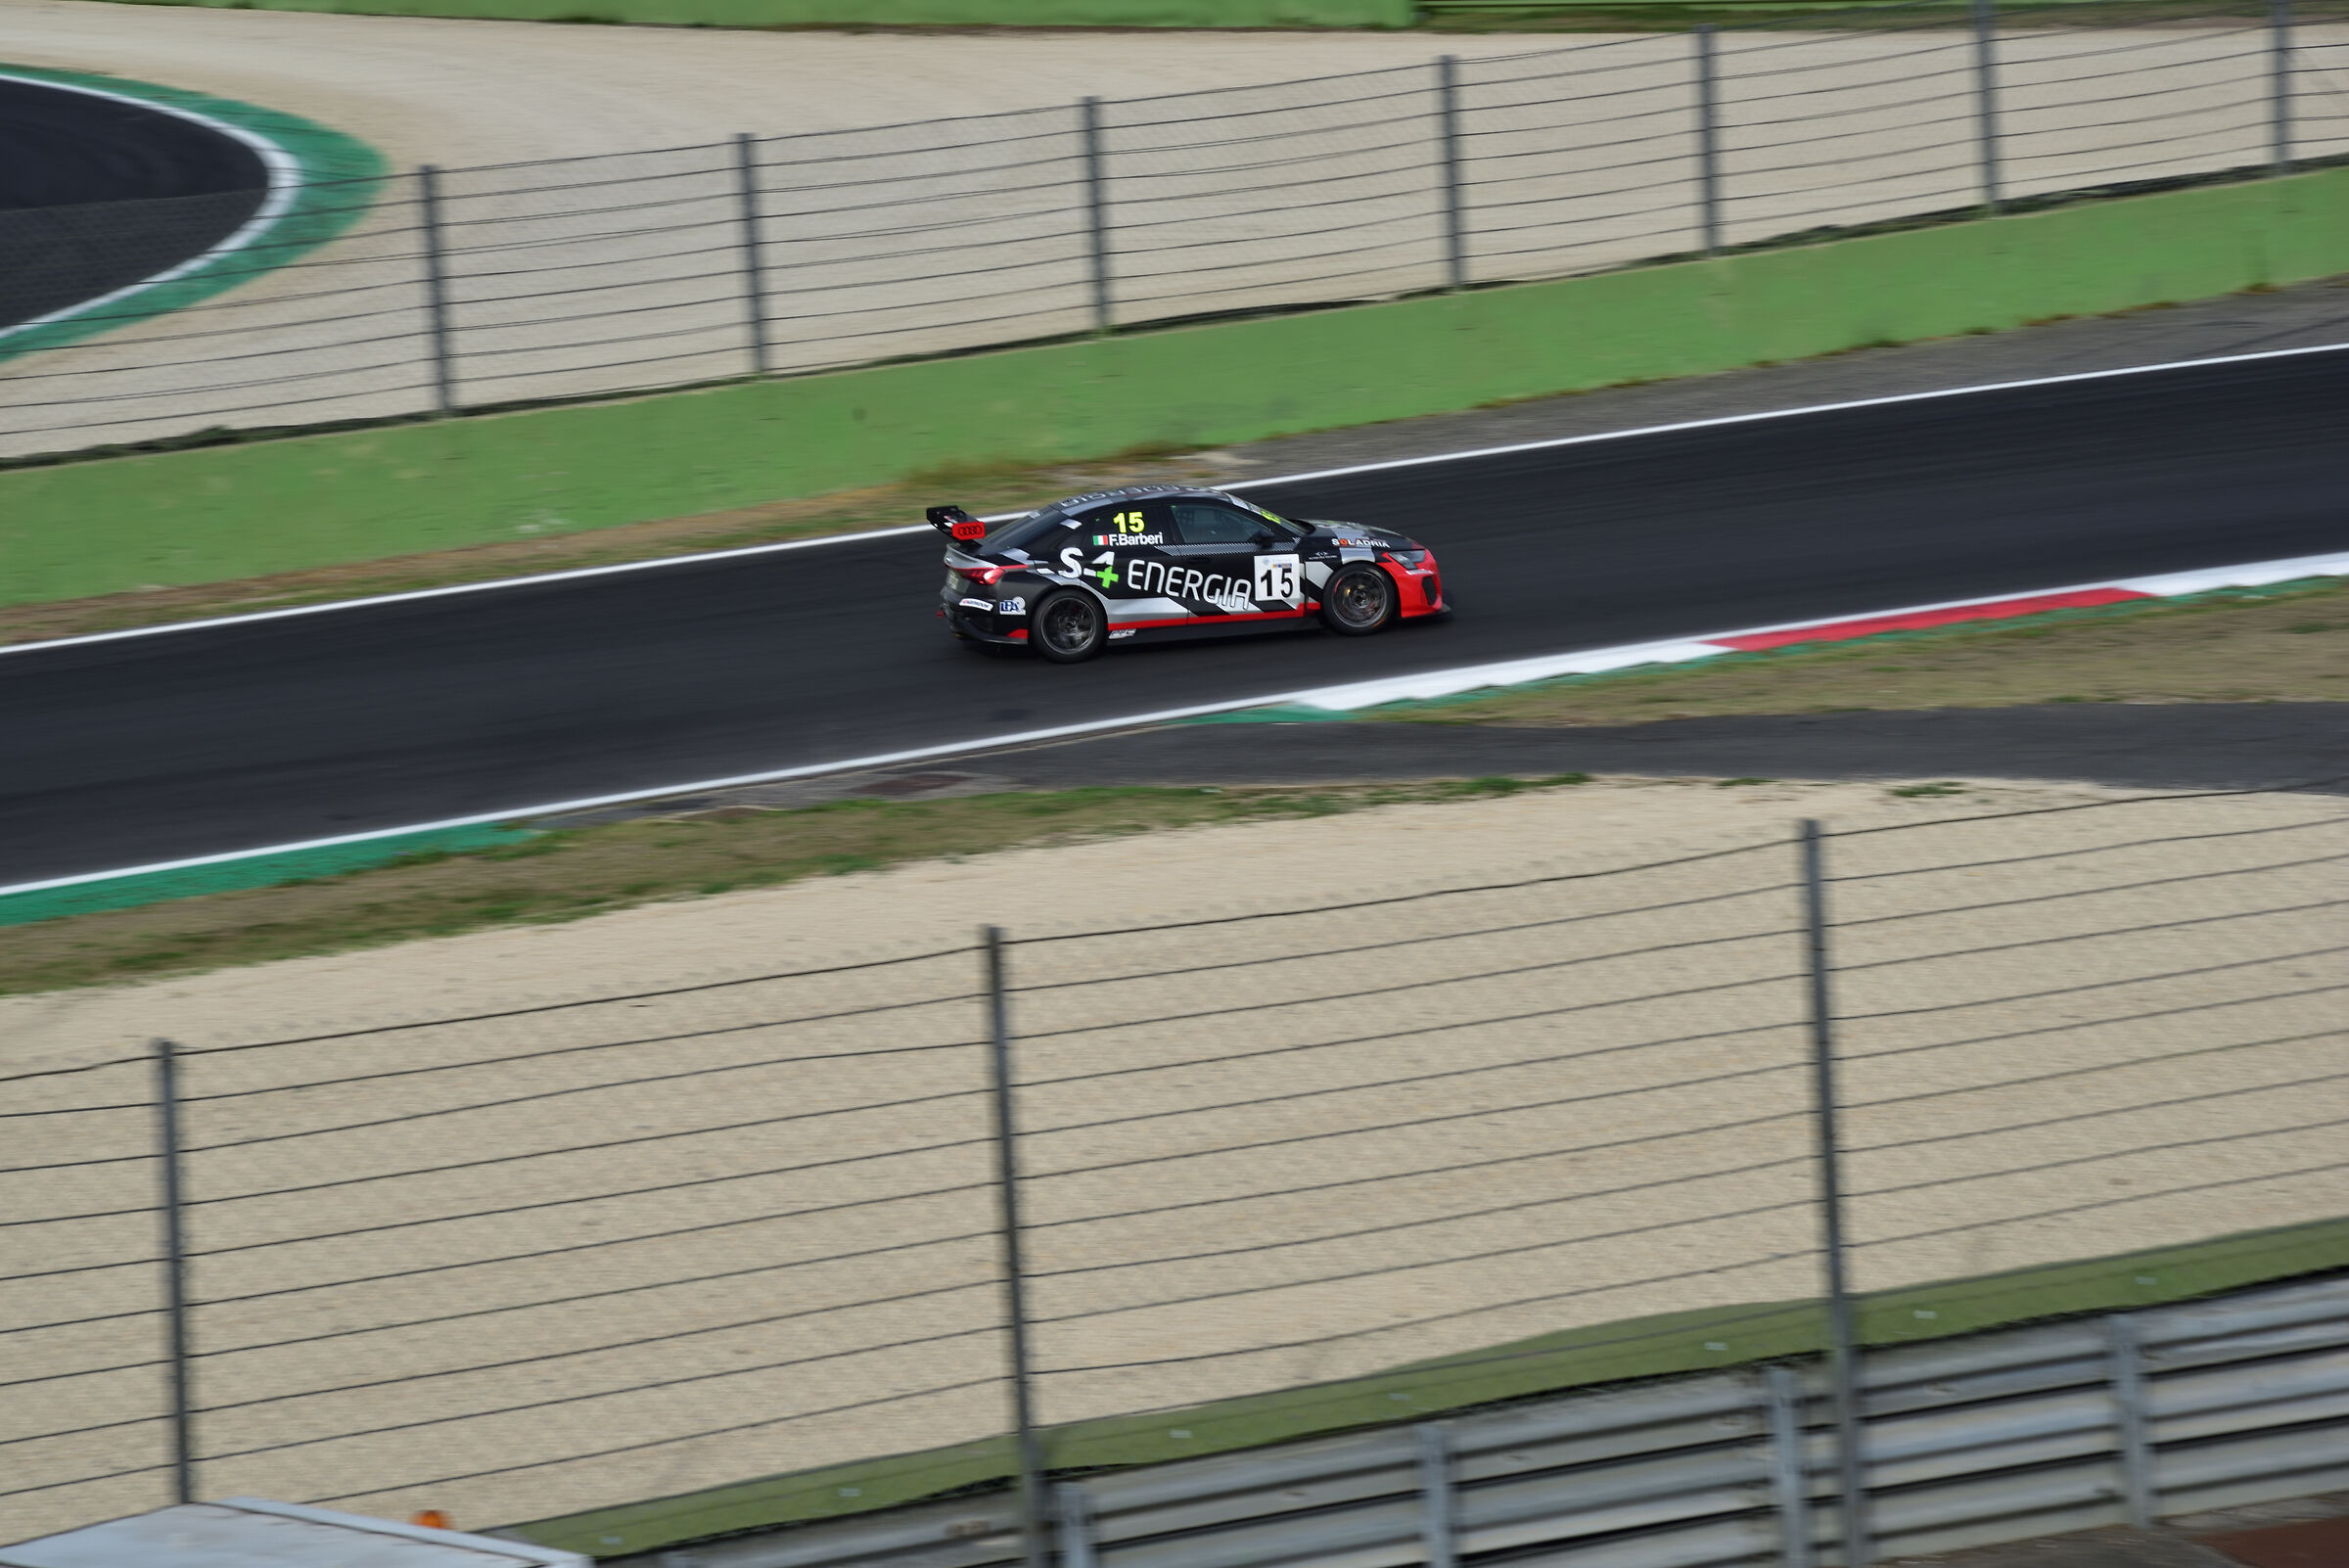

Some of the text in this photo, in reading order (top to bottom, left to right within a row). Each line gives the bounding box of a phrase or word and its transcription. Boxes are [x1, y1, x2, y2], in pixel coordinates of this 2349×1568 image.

[1114, 512, 1144, 533] 15
[1109, 531, 1163, 546] F.Barberi
[1331, 537, 1391, 549] SOLADRIA
[1128, 559, 1252, 610] ENERGIA
[1261, 568, 1293, 598] 15
